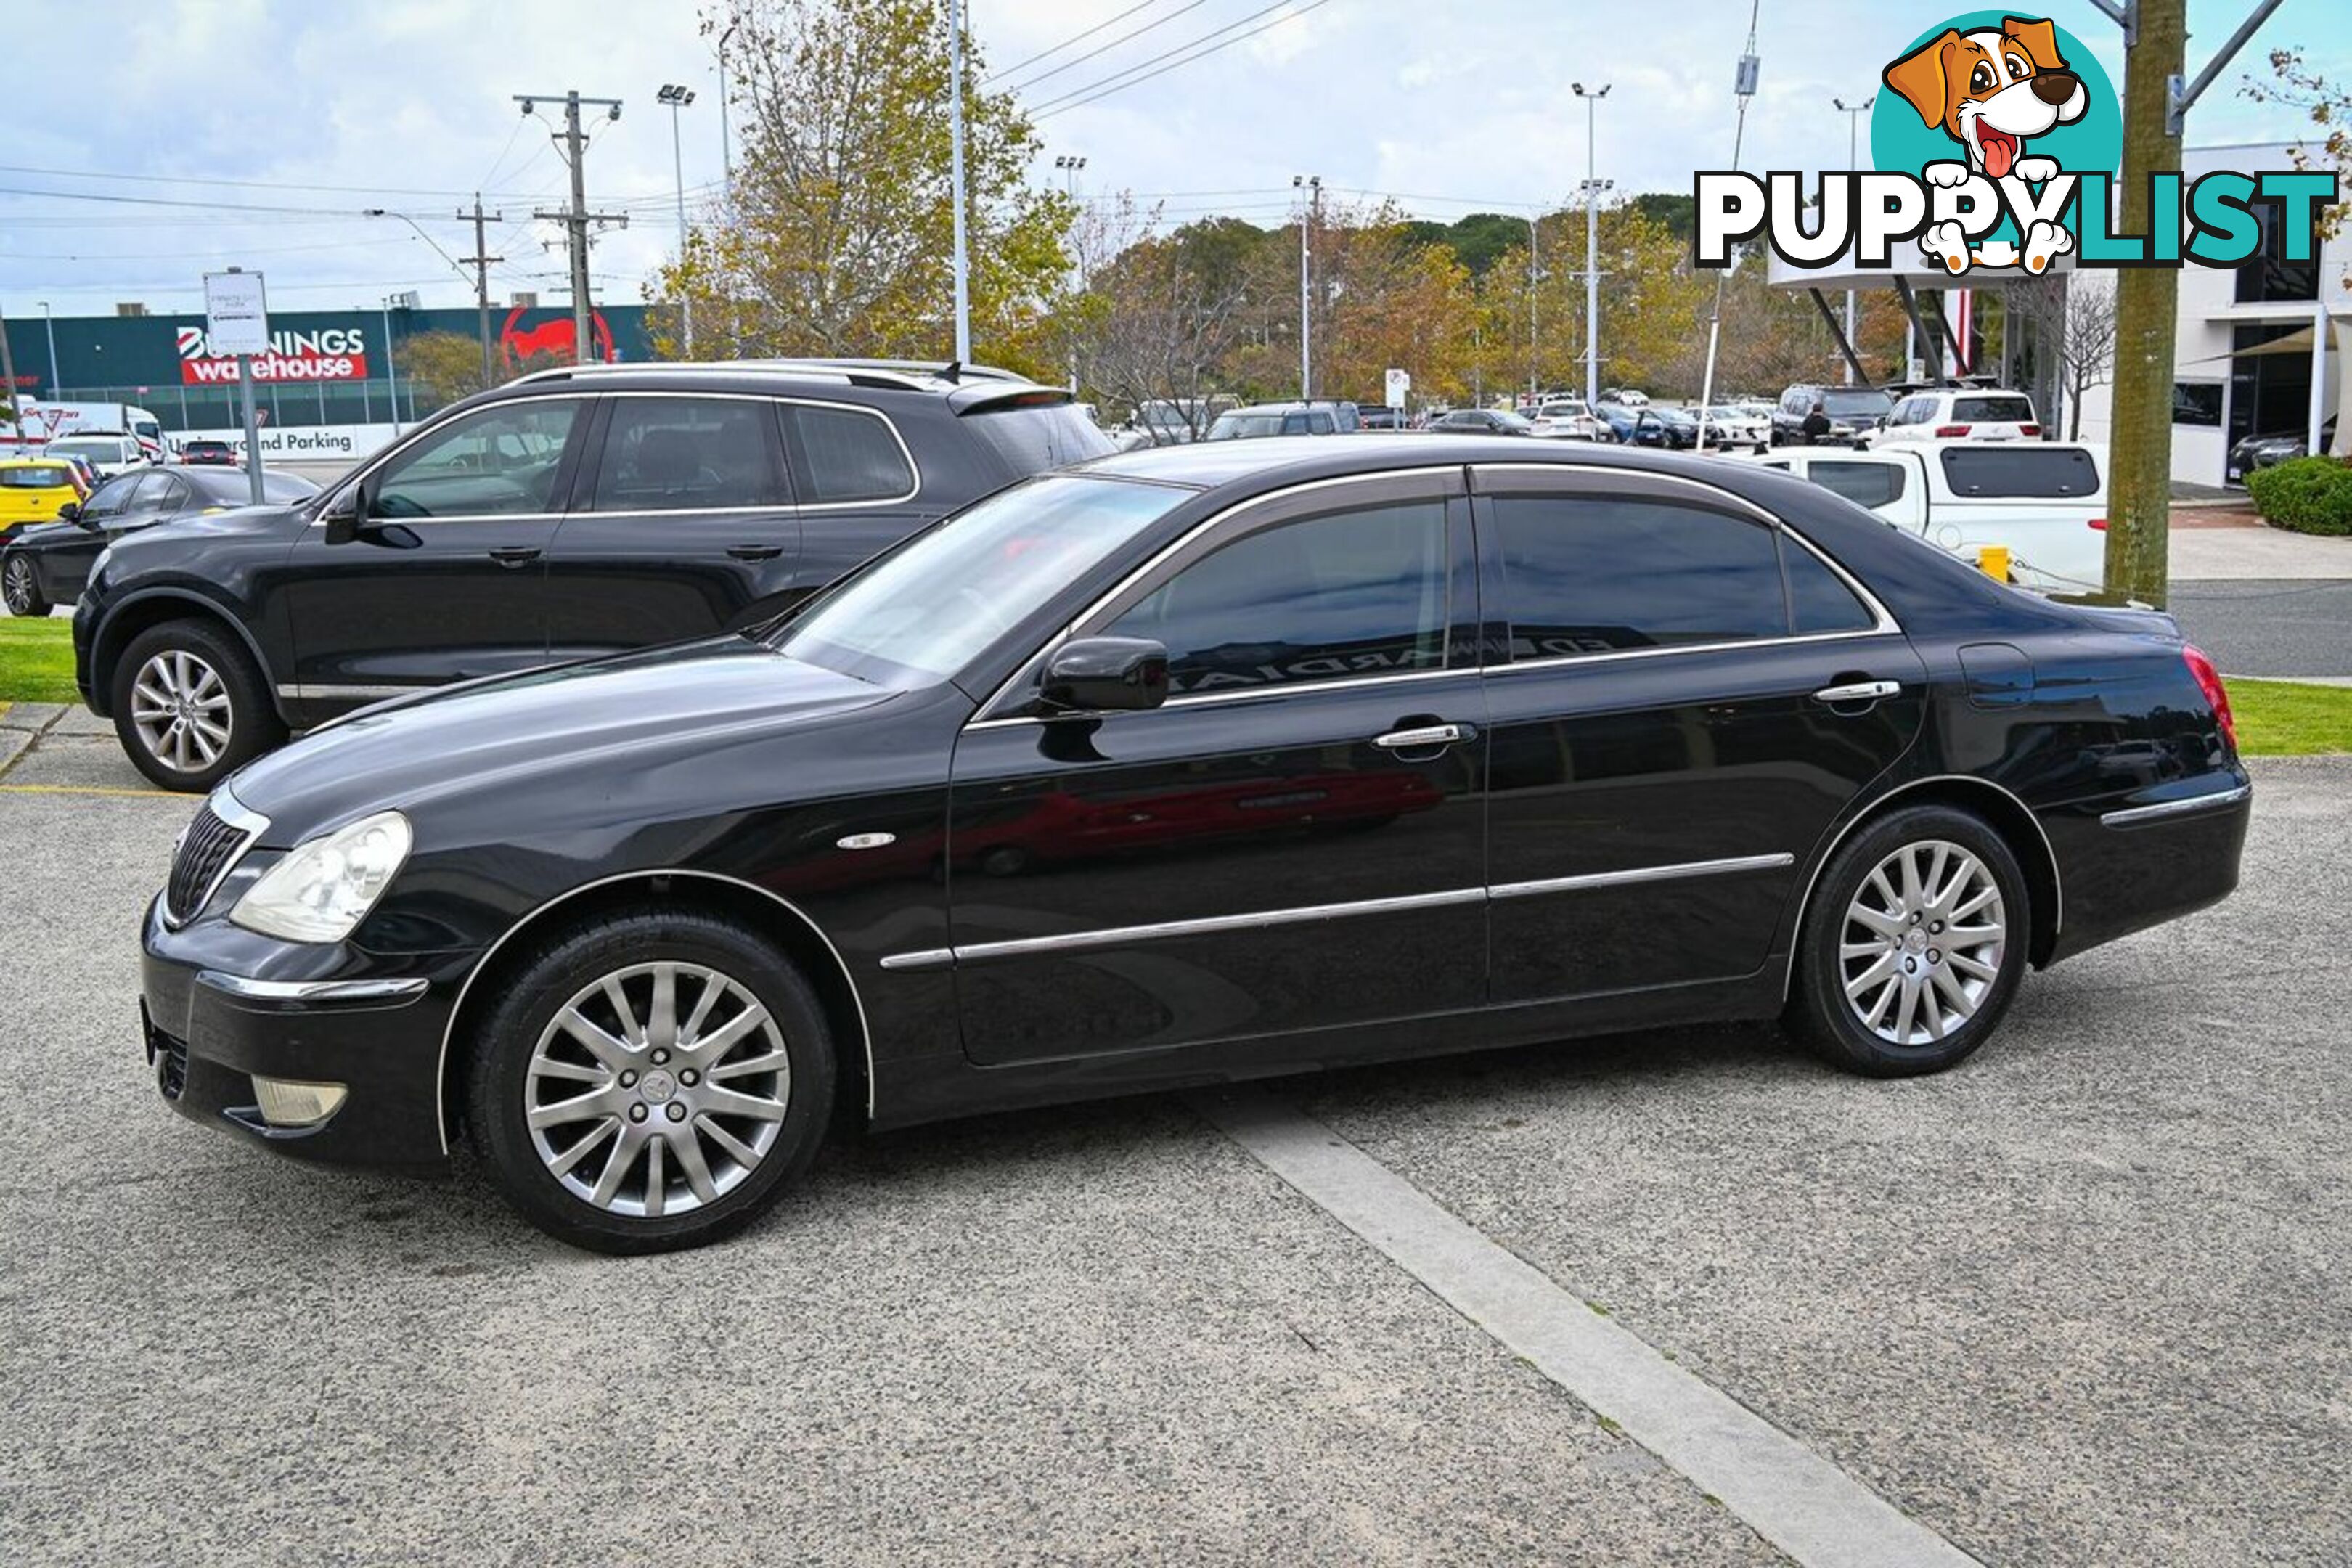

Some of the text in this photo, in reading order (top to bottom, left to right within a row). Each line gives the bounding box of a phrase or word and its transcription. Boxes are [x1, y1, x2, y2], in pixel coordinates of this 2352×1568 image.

[176, 326, 364, 359] BUNINGS
[191, 354, 354, 381] waehouse
[287, 431, 351, 452] Parking
